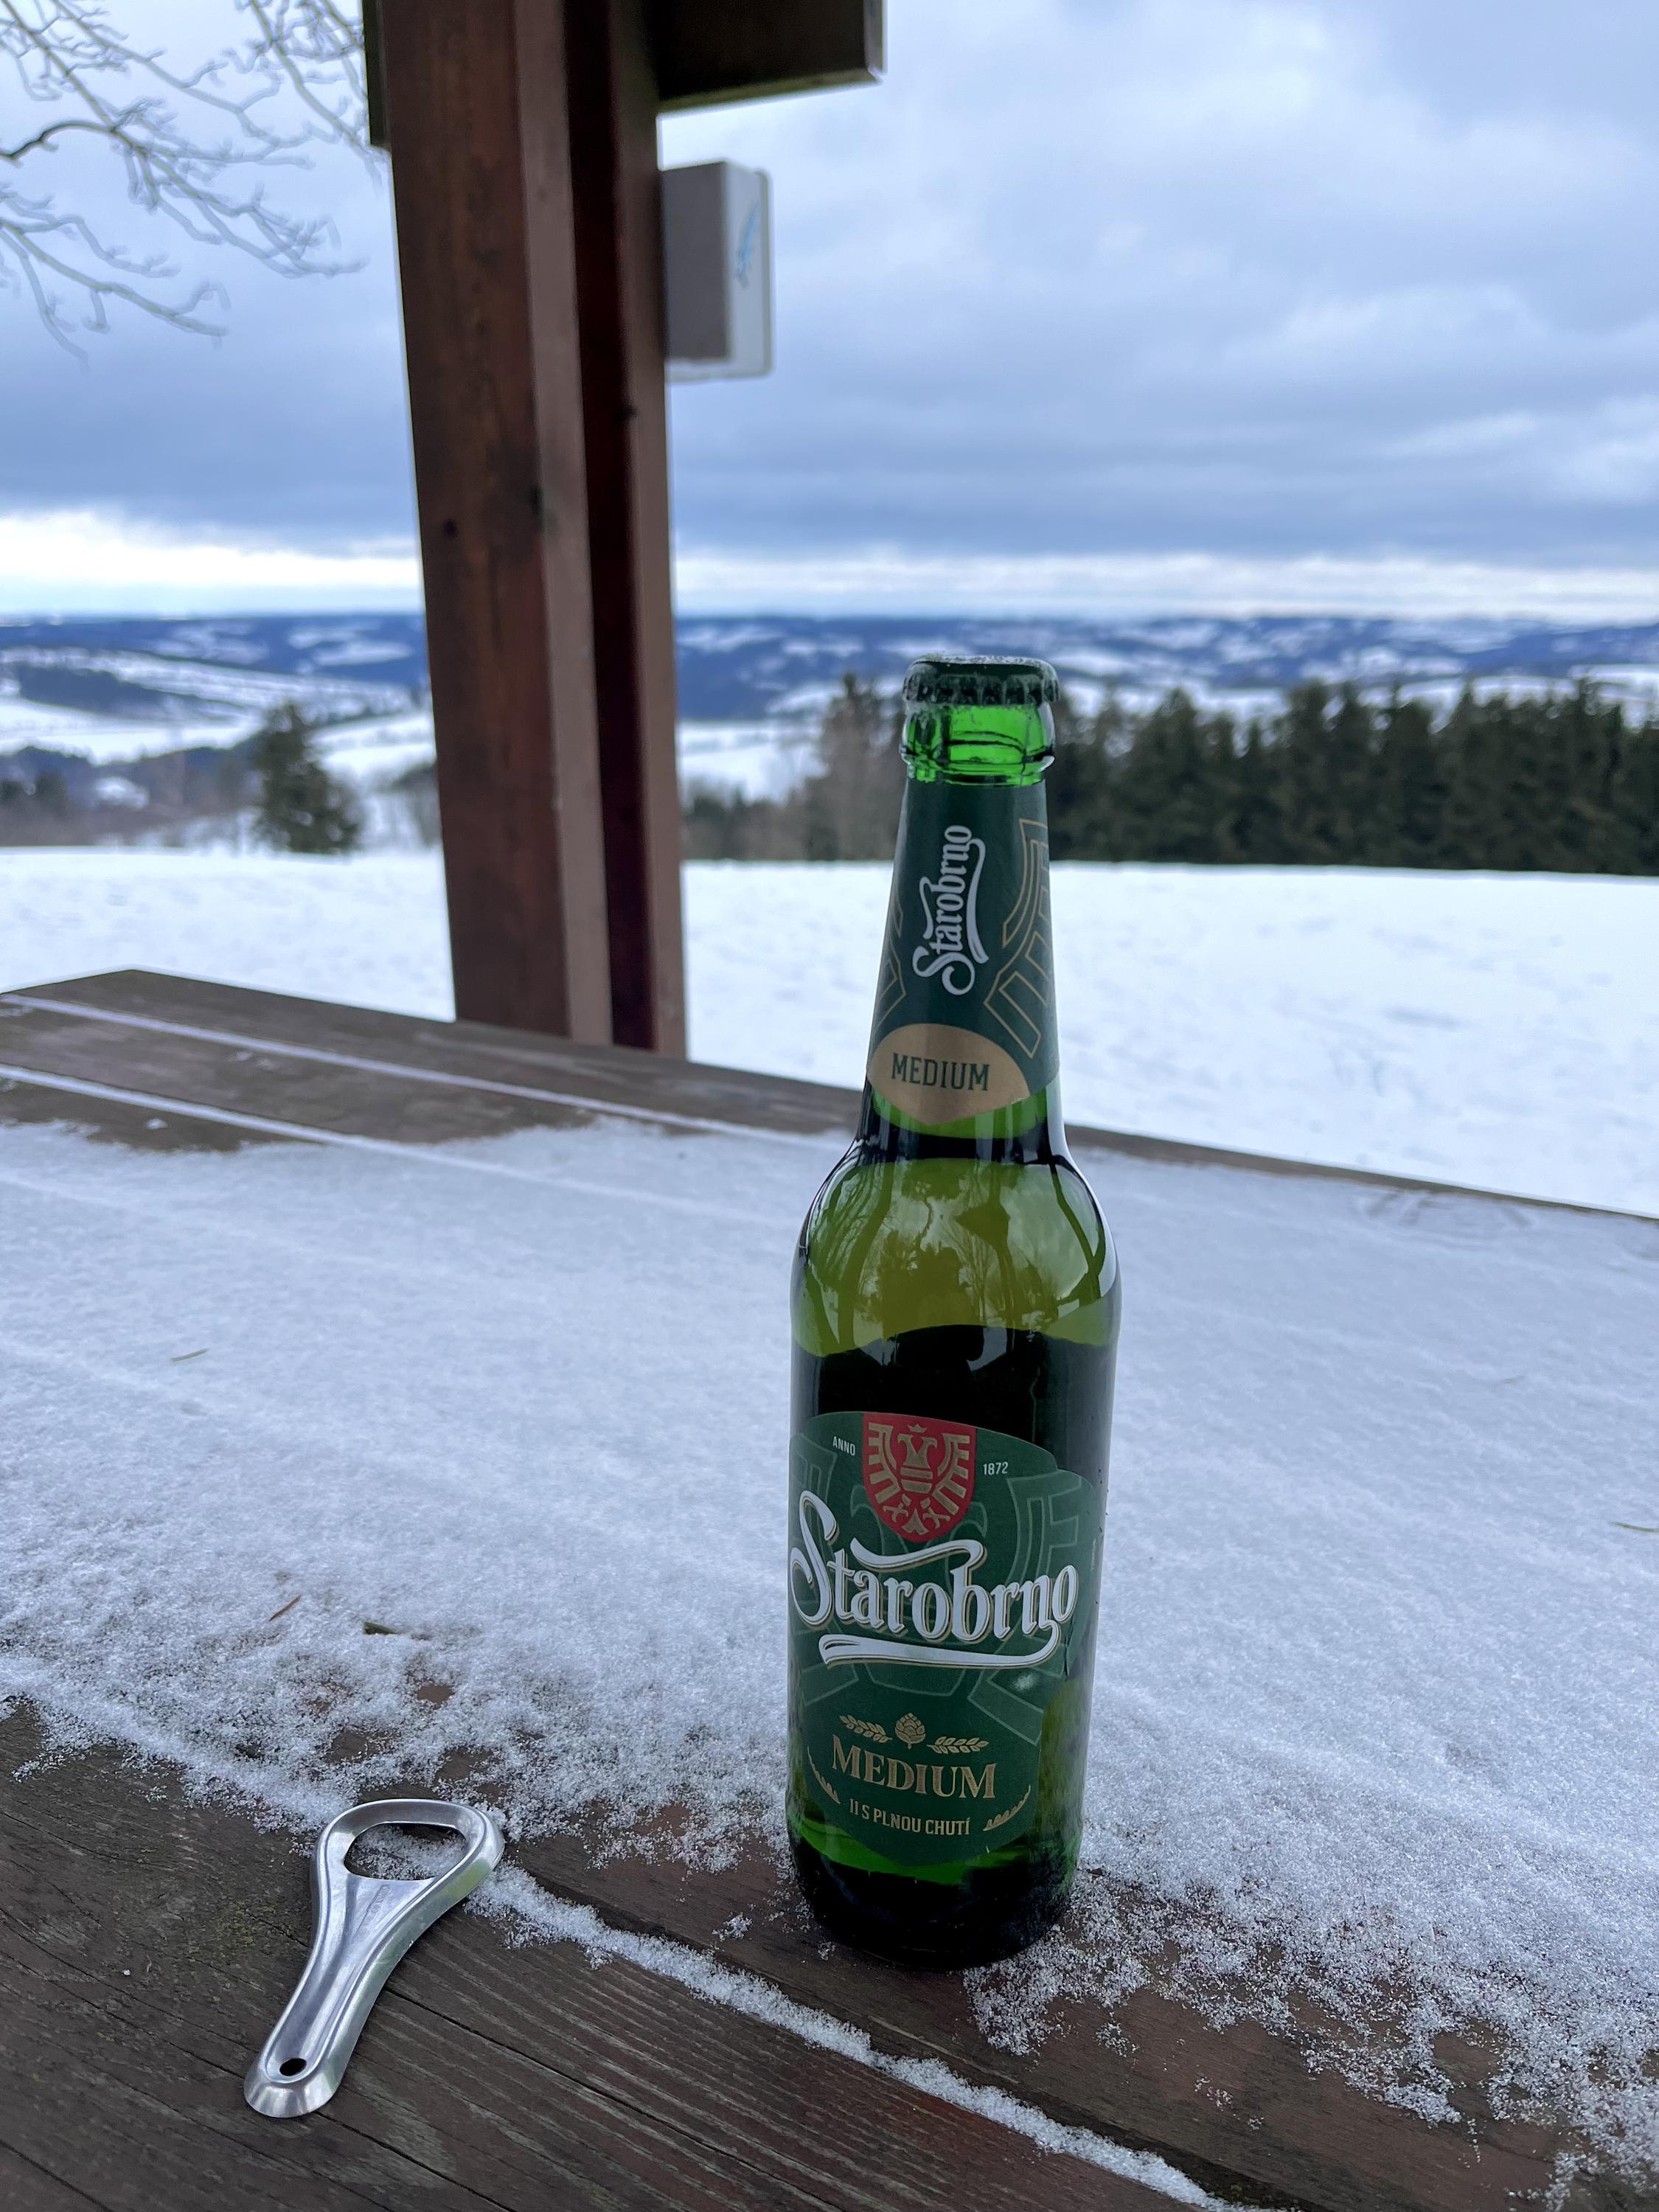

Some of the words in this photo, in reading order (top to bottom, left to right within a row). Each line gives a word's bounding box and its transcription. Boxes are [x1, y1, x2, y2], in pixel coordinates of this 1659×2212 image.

[912, 824, 990, 995] Starobrno
[891, 1052, 990, 1091] MEDIUM
[832, 1436, 856, 1456] ANNO
[982, 1461, 1009, 1476] 1872
[789, 1489, 1079, 1669] Starobrno
[830, 1734, 998, 1799] MEDIUM
[849, 1798, 859, 1816] 11
[861, 1804, 870, 1820] S
[873, 1807, 922, 1833] PLNOU
[925, 1817, 971, 1836] CHUTÍ
